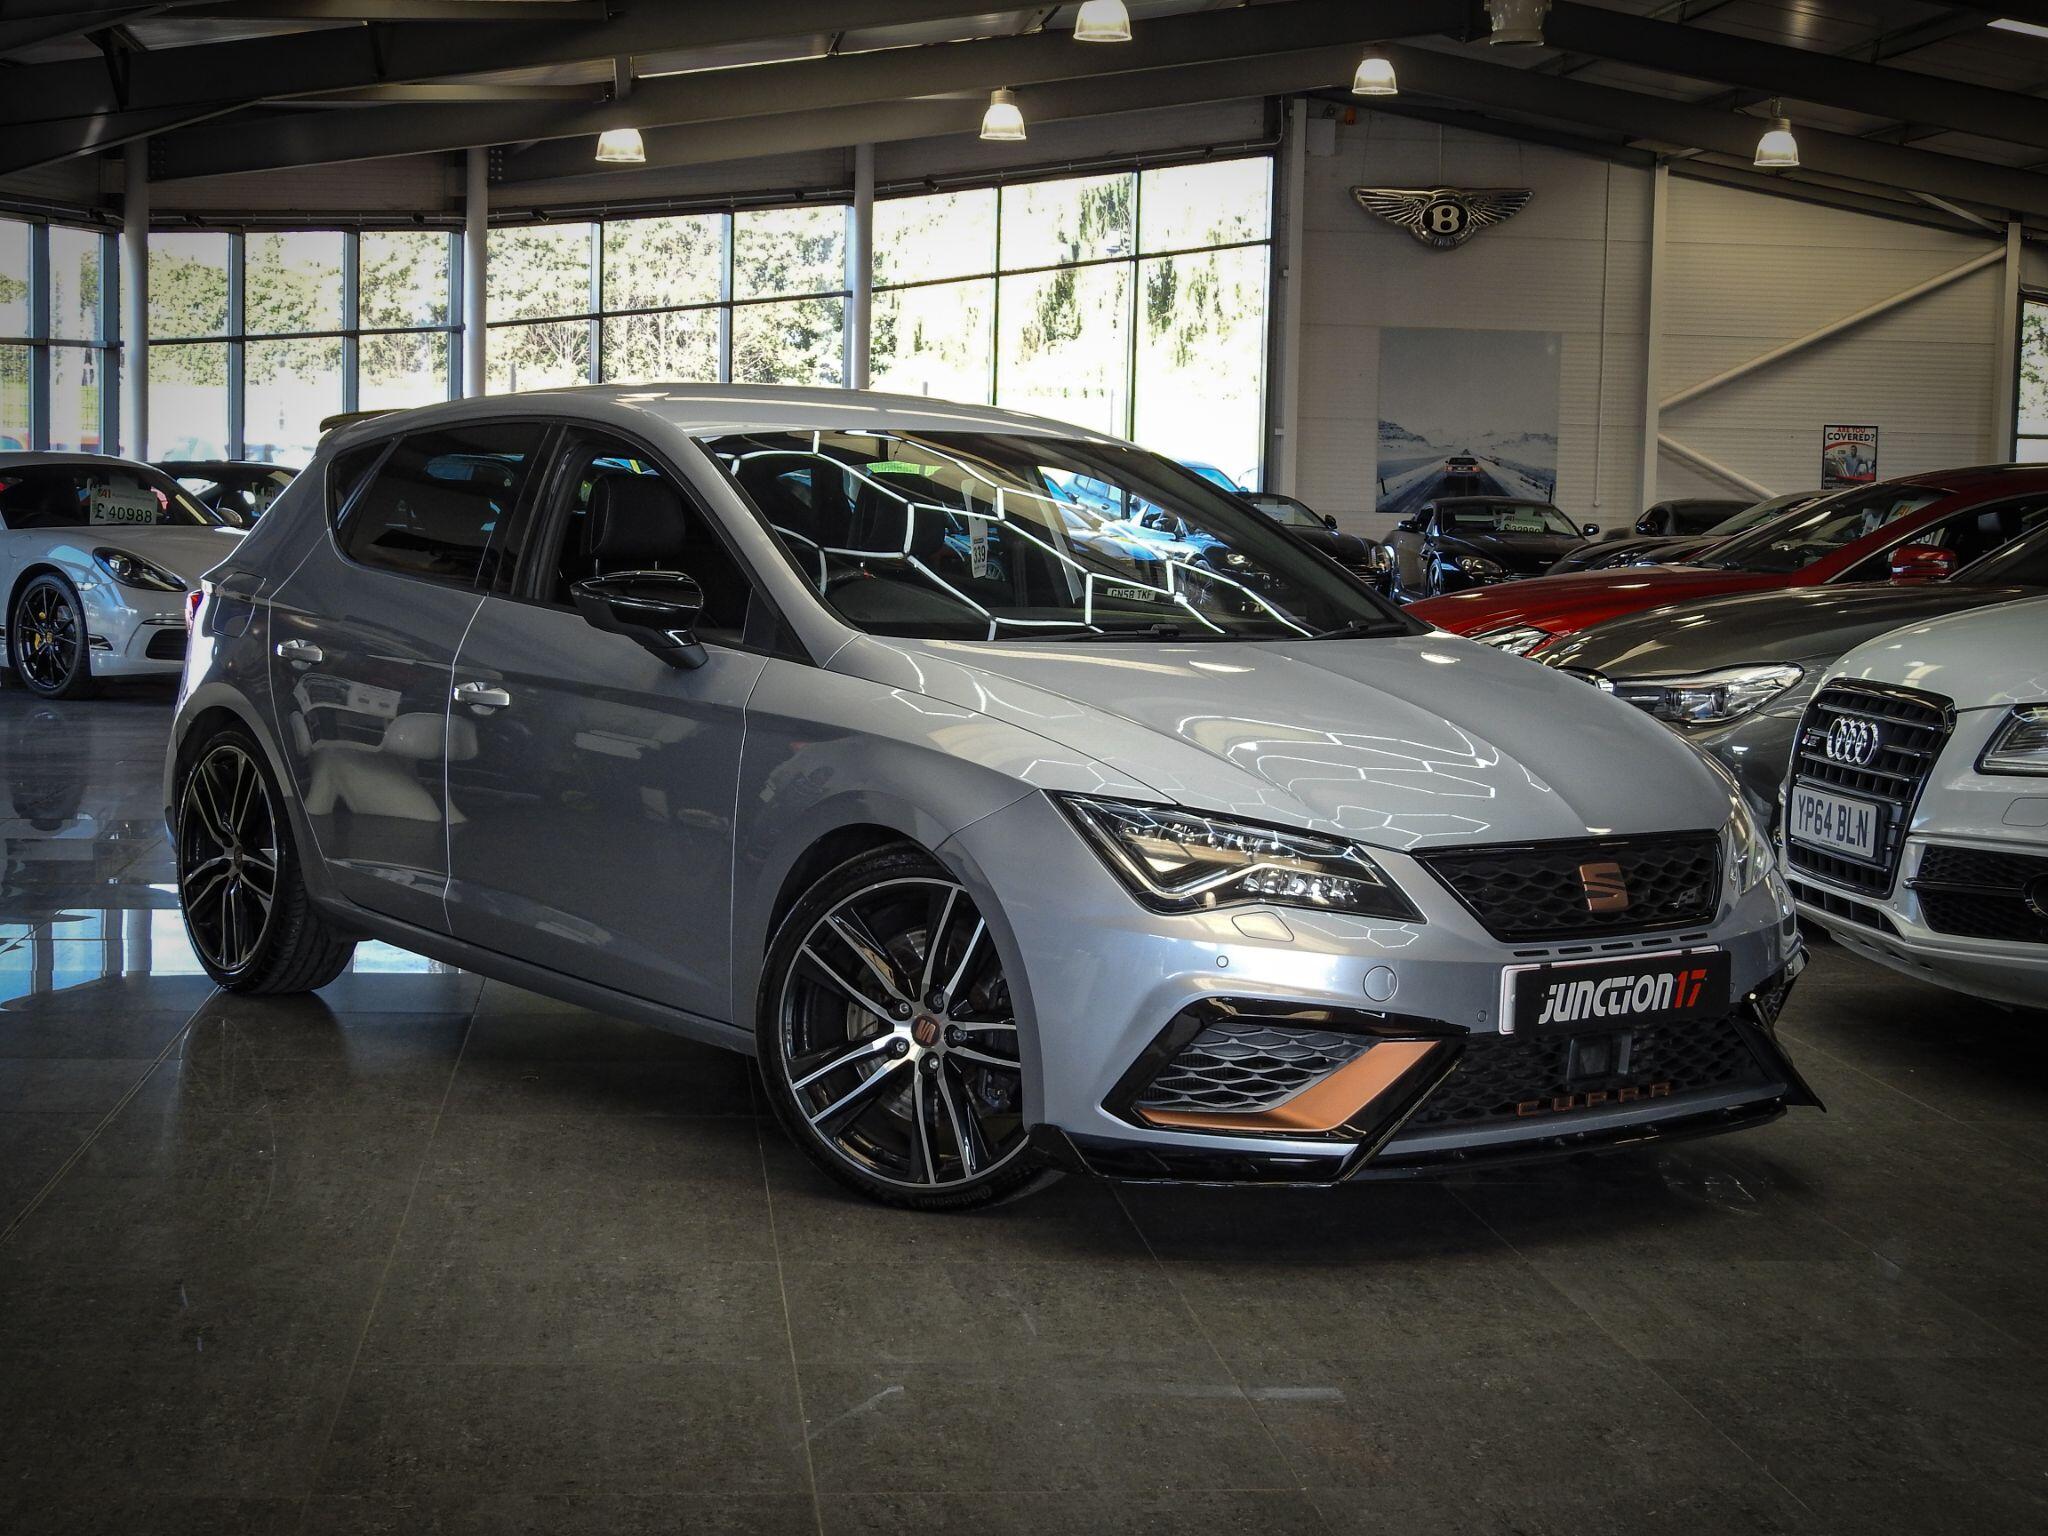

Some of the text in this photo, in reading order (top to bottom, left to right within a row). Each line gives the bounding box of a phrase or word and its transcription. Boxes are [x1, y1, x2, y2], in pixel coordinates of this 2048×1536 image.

[1827, 432, 1875, 442] COVERED?
[1798, 794, 1868, 848] YP64 BLN
